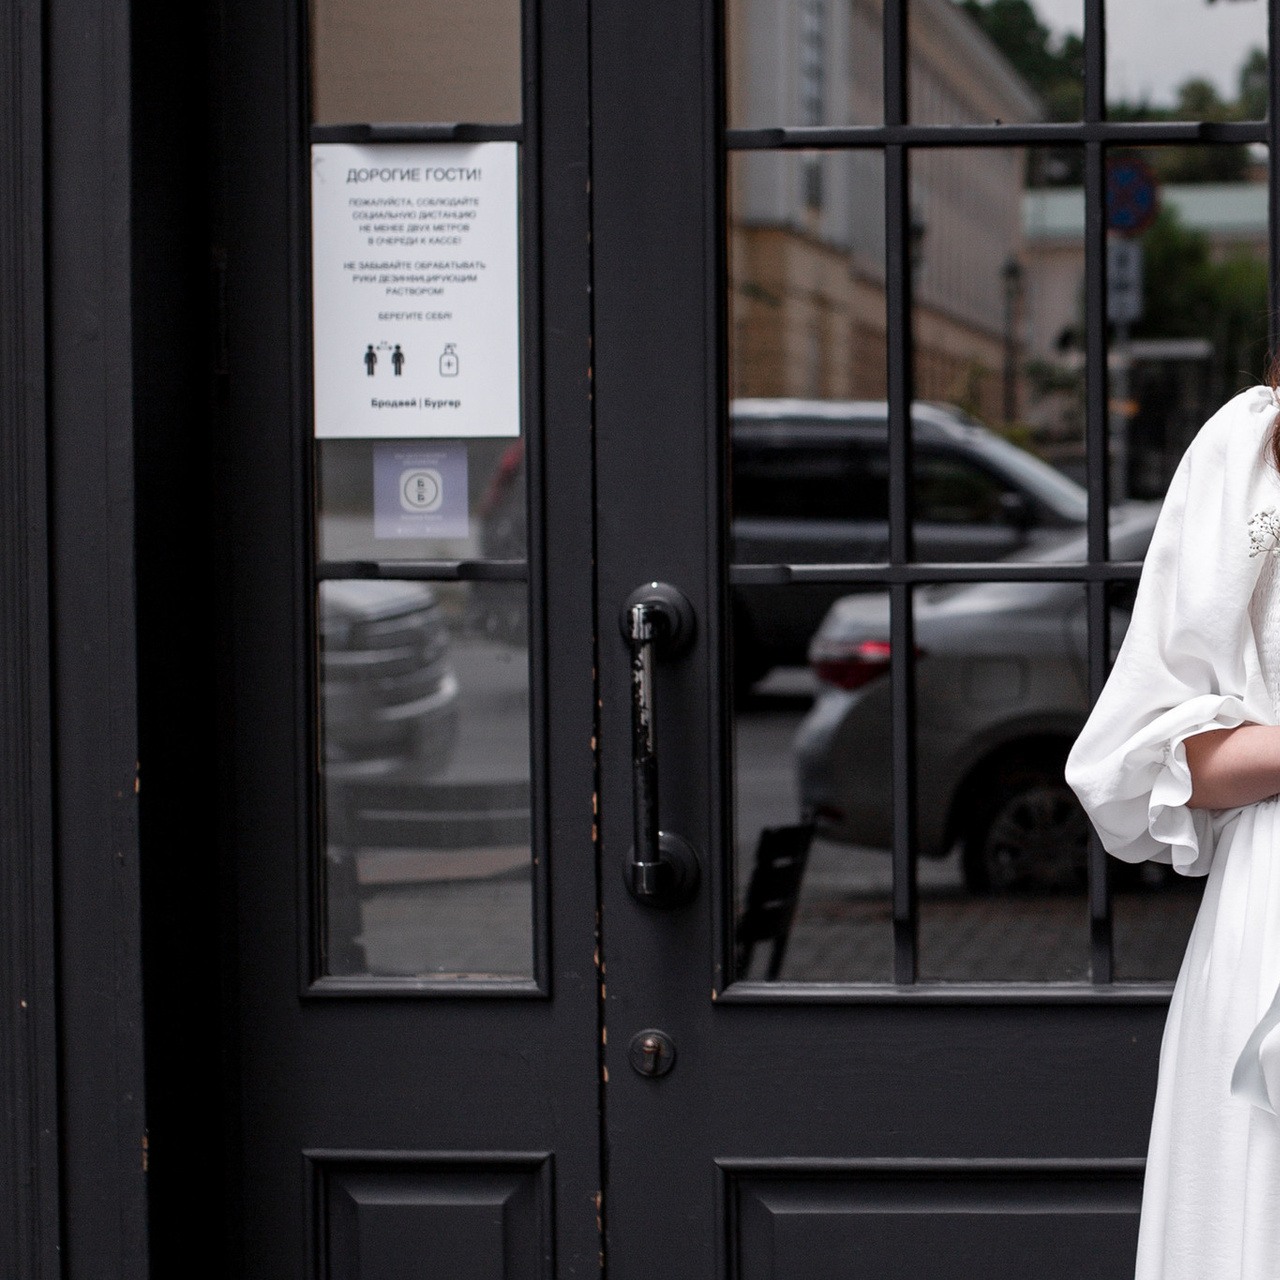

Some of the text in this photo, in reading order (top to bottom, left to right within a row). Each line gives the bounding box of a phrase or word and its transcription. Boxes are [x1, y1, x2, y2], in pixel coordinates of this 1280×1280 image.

[346, 167, 482, 184] ДОРОГИЕ ГОСТИ!
[416, 197, 479, 208] СОБЛЮДАЙТЕ
[352, 210, 476, 221] СОЦИАЛЬНУЮ ДИСТАНЦИЮ
[359, 223, 470, 233] НЕ МЕНЕЕ ДВУХ МЕТРОВ
[376, 237, 418, 246] ОЧЕРЕДИ
[343, 261, 486, 270] НЕ ЗАБЫВАЙТЕ ОБРАБАТЫВАТЬ
[352, 274, 376, 282] РУКИ
[378, 312, 422, 321] БЕРЕГИТЕ
[371, 398, 417, 409] Бродвей
[424, 398, 461, 409] Бургер
